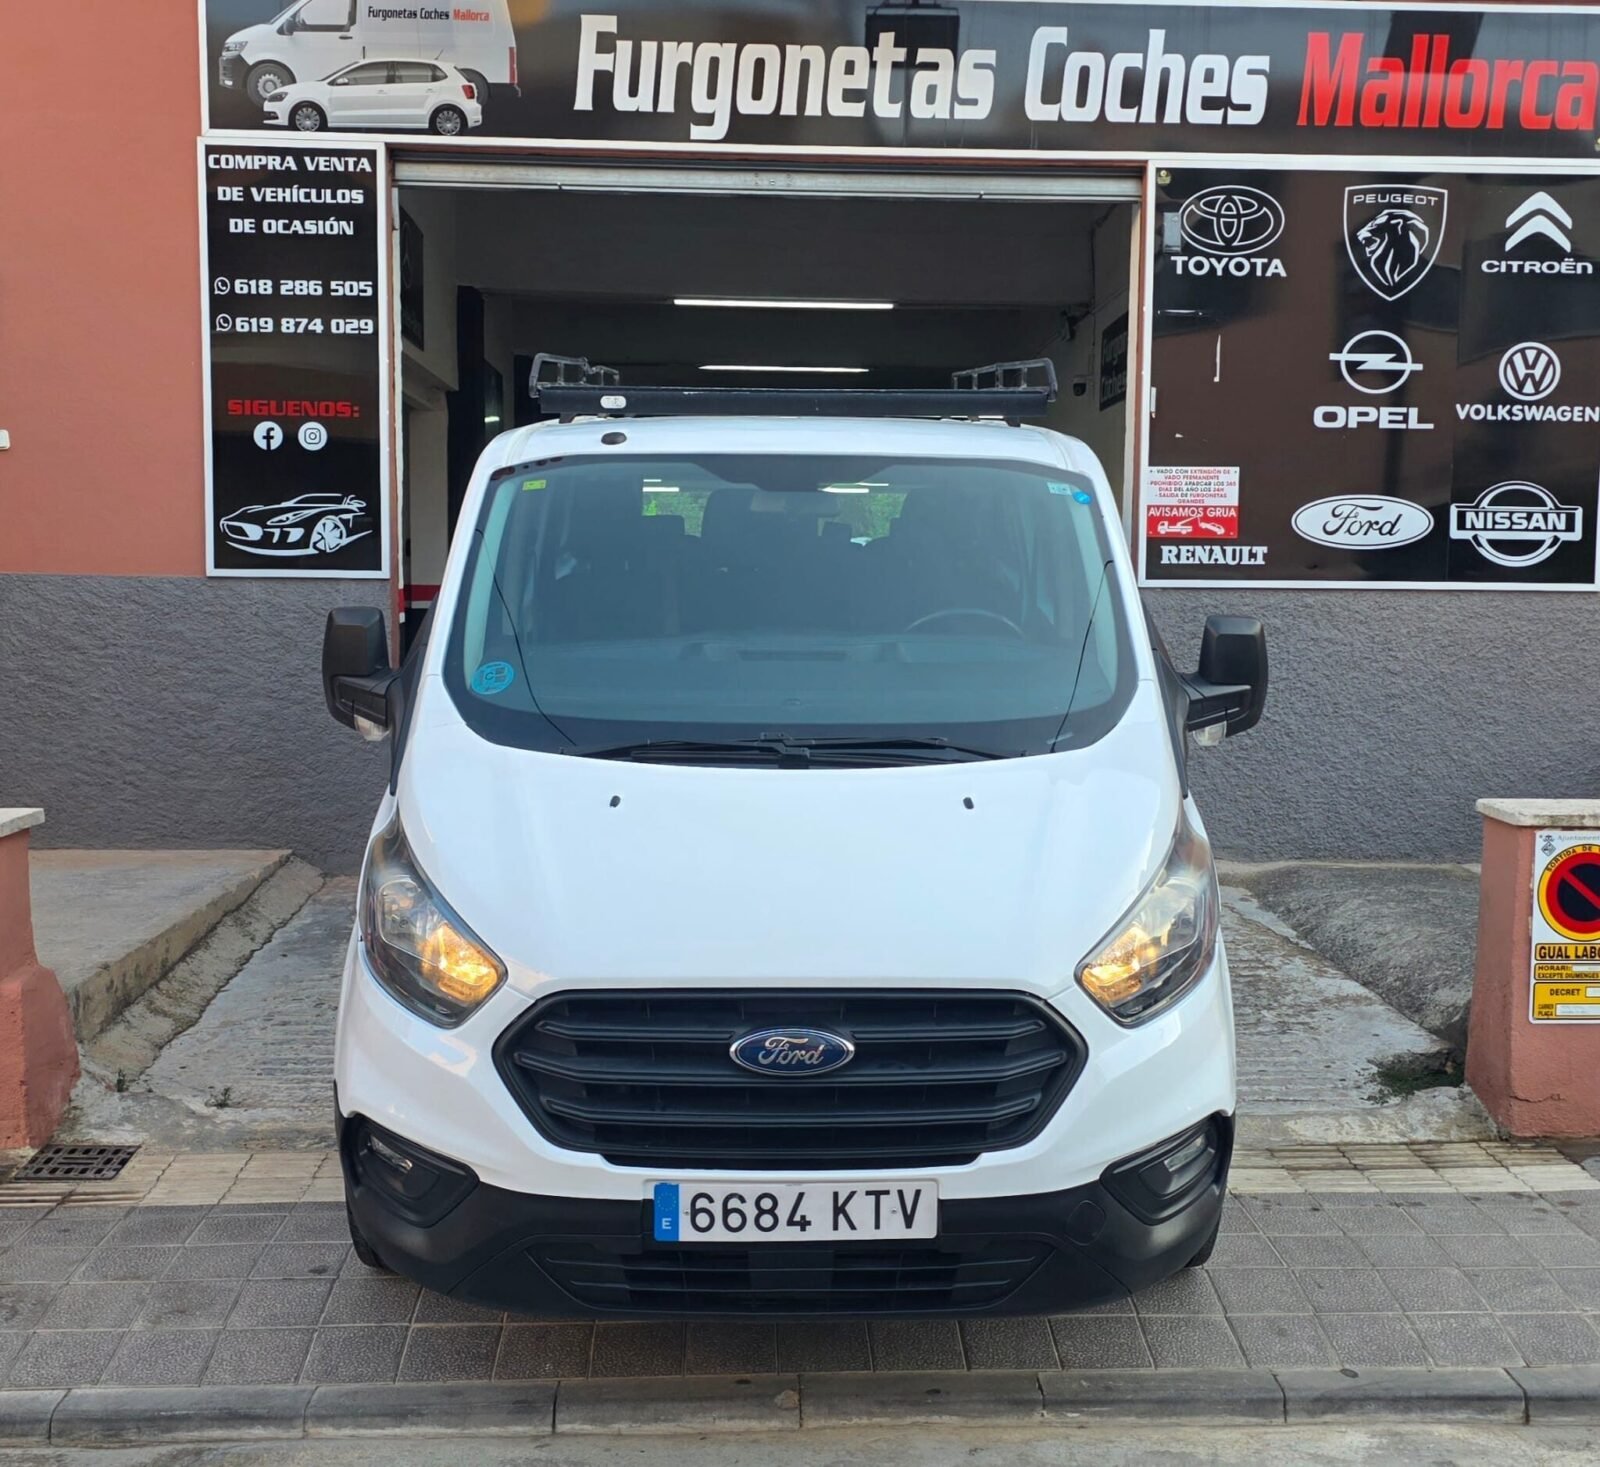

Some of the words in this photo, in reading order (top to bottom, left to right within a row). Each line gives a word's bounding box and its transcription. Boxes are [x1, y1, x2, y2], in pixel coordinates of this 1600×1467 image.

[368, 6, 418, 21] Furgonetas
[420, 8, 450, 20] Coches
[453, 9, 490, 21] Mallorca
[573, 14, 997, 141] Furgonetas
[1024, 25, 1270, 125] Coches
[1296, 31, 1600, 131] Mallorca
[208, 154, 298, 170] COMPRA
[304, 156, 372, 172] VENTA
[217, 186, 244, 201] DE
[250, 184, 364, 204] VEHÍCULOS
[1352, 193, 1439, 206] PEUGEOT
[229, 218, 256, 233] DE
[262, 217, 354, 235] OCASIÓN
[1170, 255, 1288, 278] TOYOTA
[234, 279, 273, 295] 618
[279, 280, 323, 296] 286
[330, 281, 373, 296] 505
[235, 317, 274, 333] 619
[281, 318, 324, 333] 874
[331, 319, 374, 334] 029
[227, 399, 360, 418] SIGUENOS:
[1313, 406, 1434, 430] OPEL
[1455, 403, 1600, 422] VOLKSWAGEN
[1148, 507, 1203, 517] AVISAMOS
[1206, 507, 1237, 517] GRUA
[1321, 503, 1400, 537] Ford
[1464, 510, 1567, 531] NISSAN
[1160, 545, 1268, 566] RENAULT
[1547, 848, 1577, 872] SORTIDA
[1538, 946, 1570, 959] GUAL
[1549, 988, 1580, 996] DECRET
[758, 1036, 824, 1065] Ford
[661, 1217, 672, 1230] E
[689, 1191, 812, 1233] 6684
[832, 1188, 922, 1232] KTV
